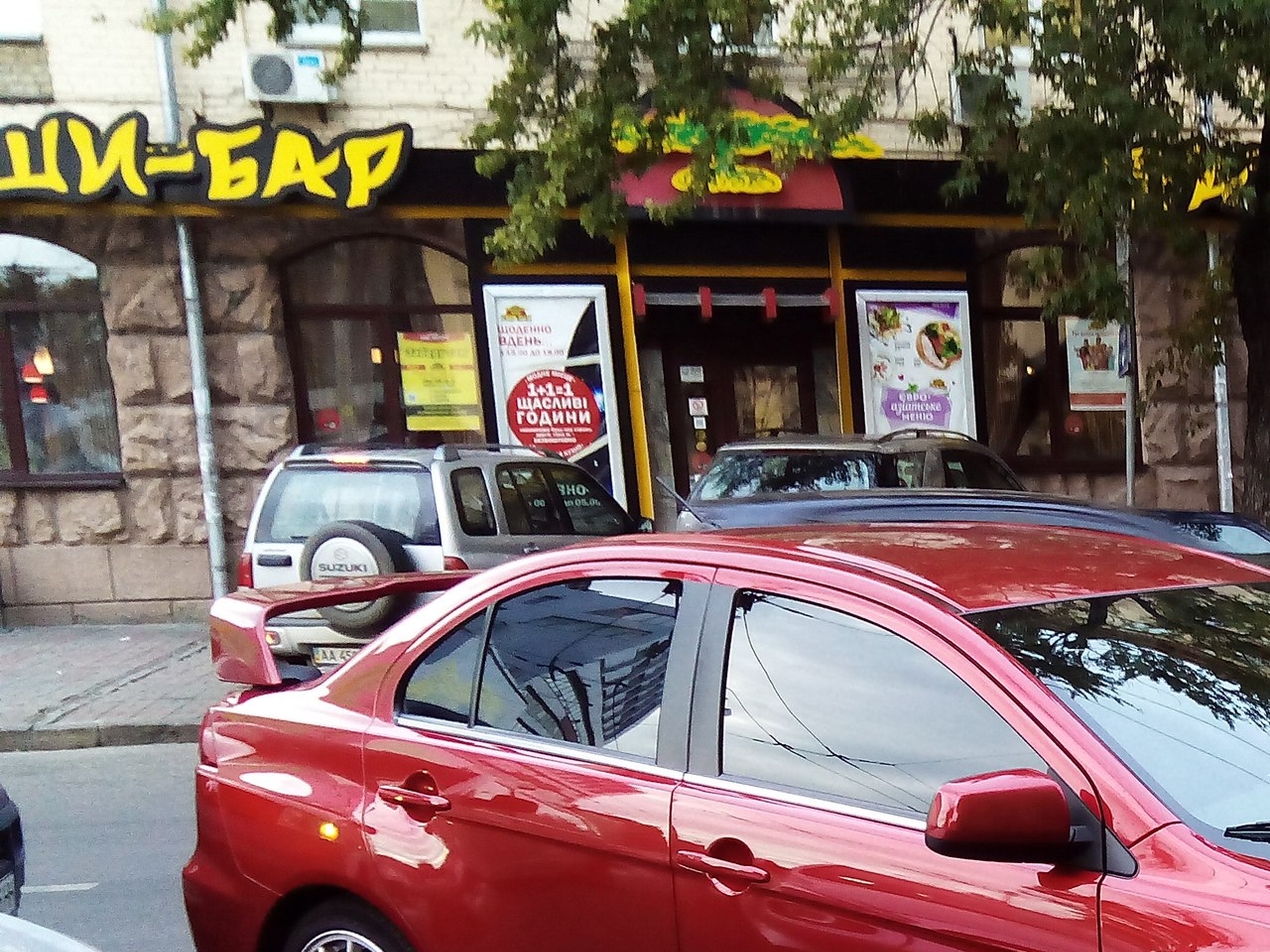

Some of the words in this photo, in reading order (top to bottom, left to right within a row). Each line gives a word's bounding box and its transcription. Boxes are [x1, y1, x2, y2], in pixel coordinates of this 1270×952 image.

[527, 382, 574, 397] 1+1=1
[516, 397, 588, 411] ЩАСЛИВІ
[516, 410, 592, 427] ГОДИНИ
[318, 563, 368, 573] SUZUKI
